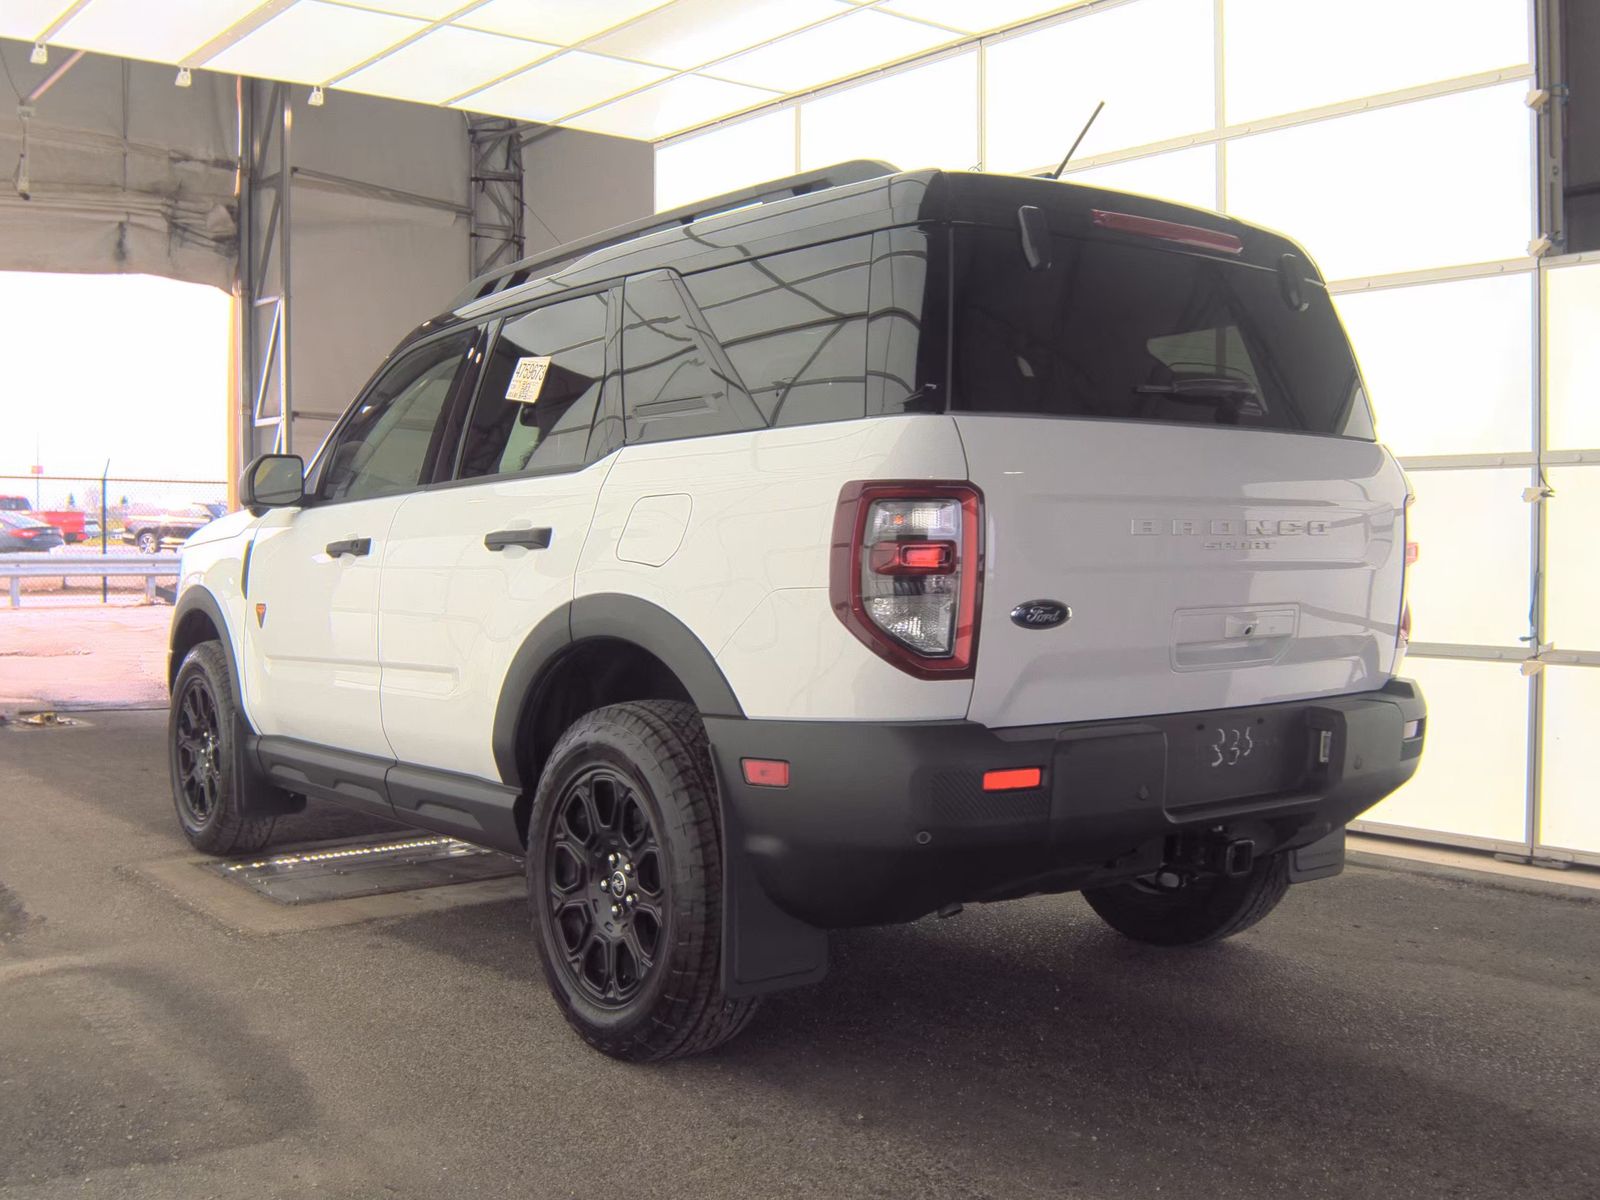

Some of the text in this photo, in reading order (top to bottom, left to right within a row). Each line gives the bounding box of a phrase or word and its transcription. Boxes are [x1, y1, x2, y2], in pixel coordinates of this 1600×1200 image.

[1130, 519, 1331, 537] BRONCO
[1203, 540, 1277, 551] SPORT
[1026, 605, 1061, 622] Ford
